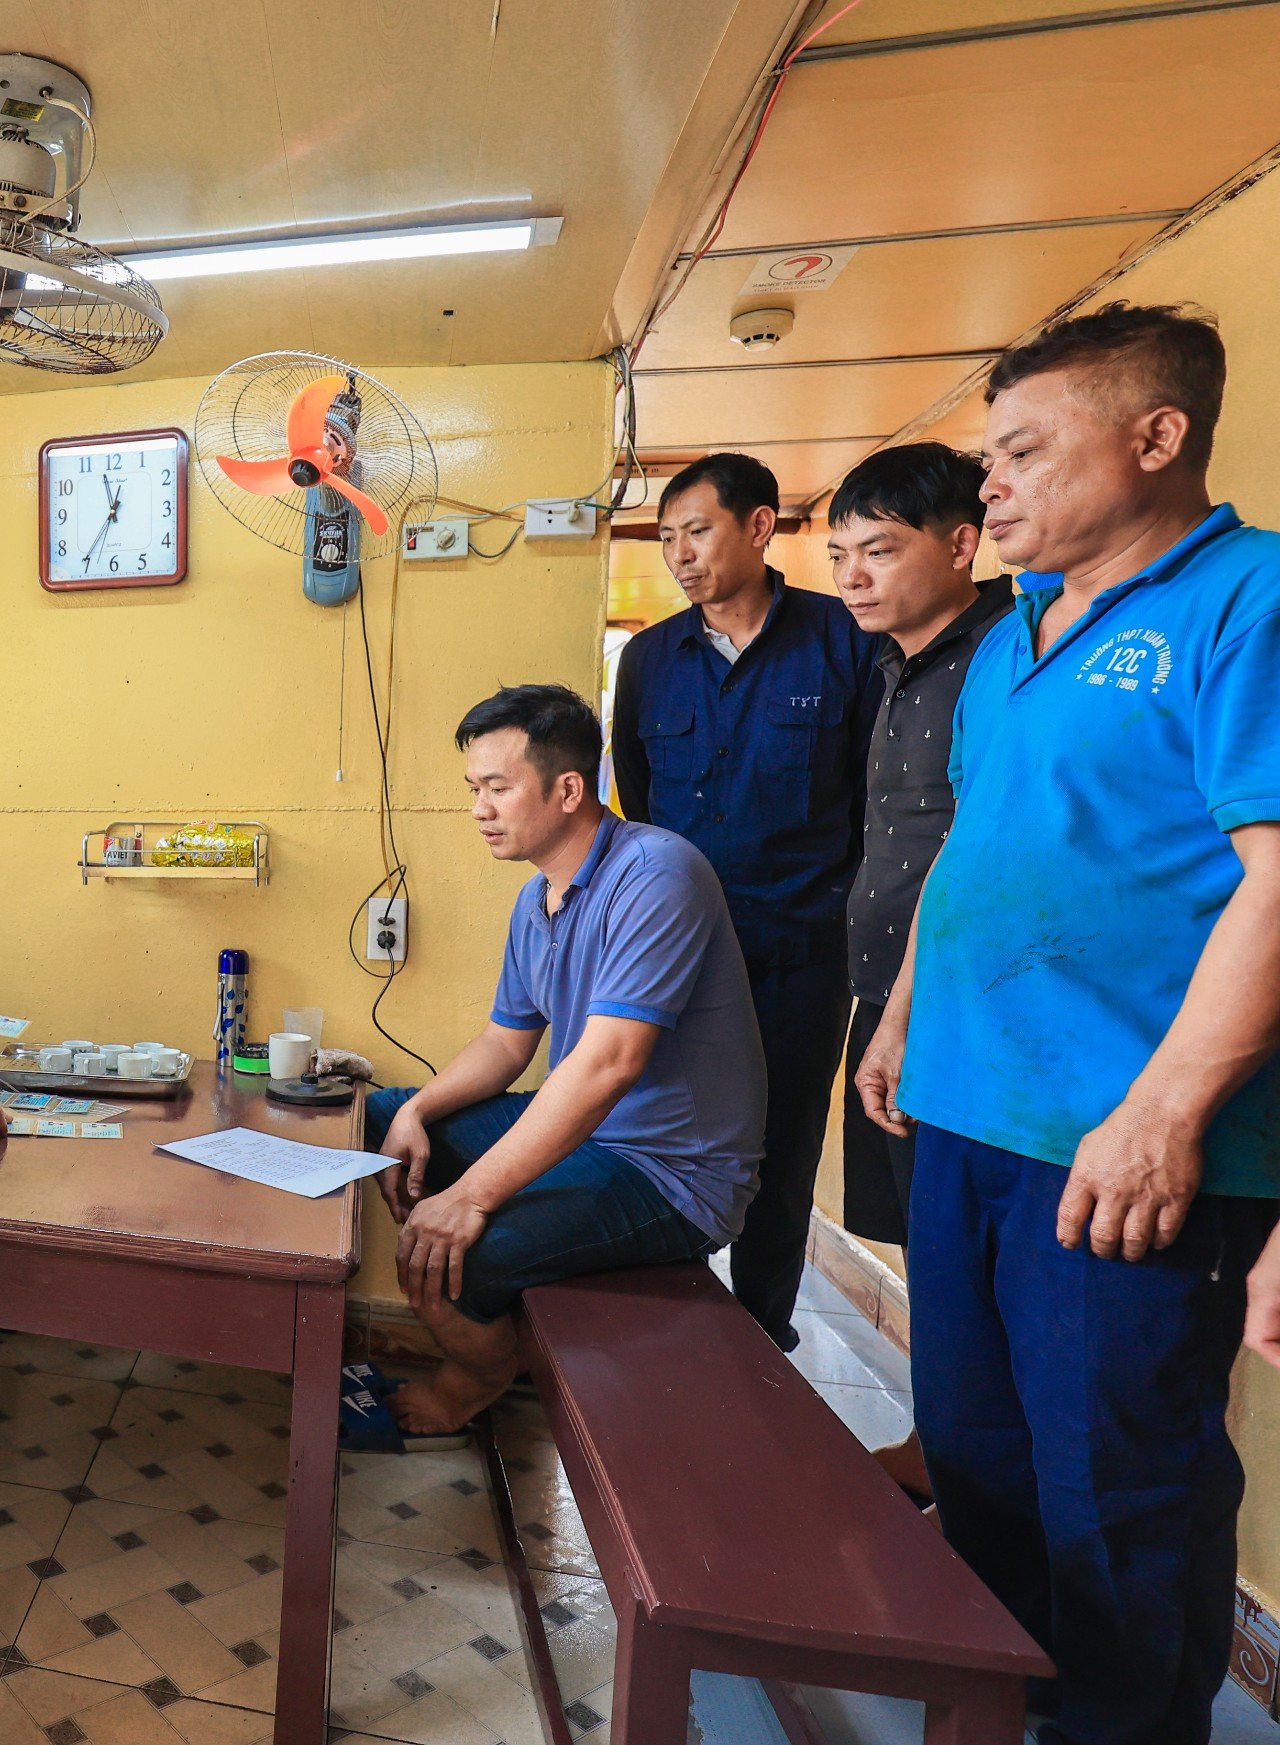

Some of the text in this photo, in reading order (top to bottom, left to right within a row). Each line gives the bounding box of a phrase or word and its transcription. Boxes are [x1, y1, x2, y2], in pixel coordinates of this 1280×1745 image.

[80, 456, 92, 473] 11
[106, 453, 122, 470] 12
[139, 451, 146, 467] 1
[161, 469, 171, 486] 2
[58, 479, 73, 496] 10
[58, 509, 67, 525] 9
[163, 501, 171, 517] 3
[58, 540, 66, 556] 8
[161, 532, 171, 548] 4
[109, 555, 119, 572] 6
[138, 553, 147, 570] 5
[1117, 629, 1143, 642] THPT
[1140, 629, 1166, 648] XUÂN
[1106, 647, 1147, 673] 12C
[1087, 673, 1139, 691] 1986 1989
